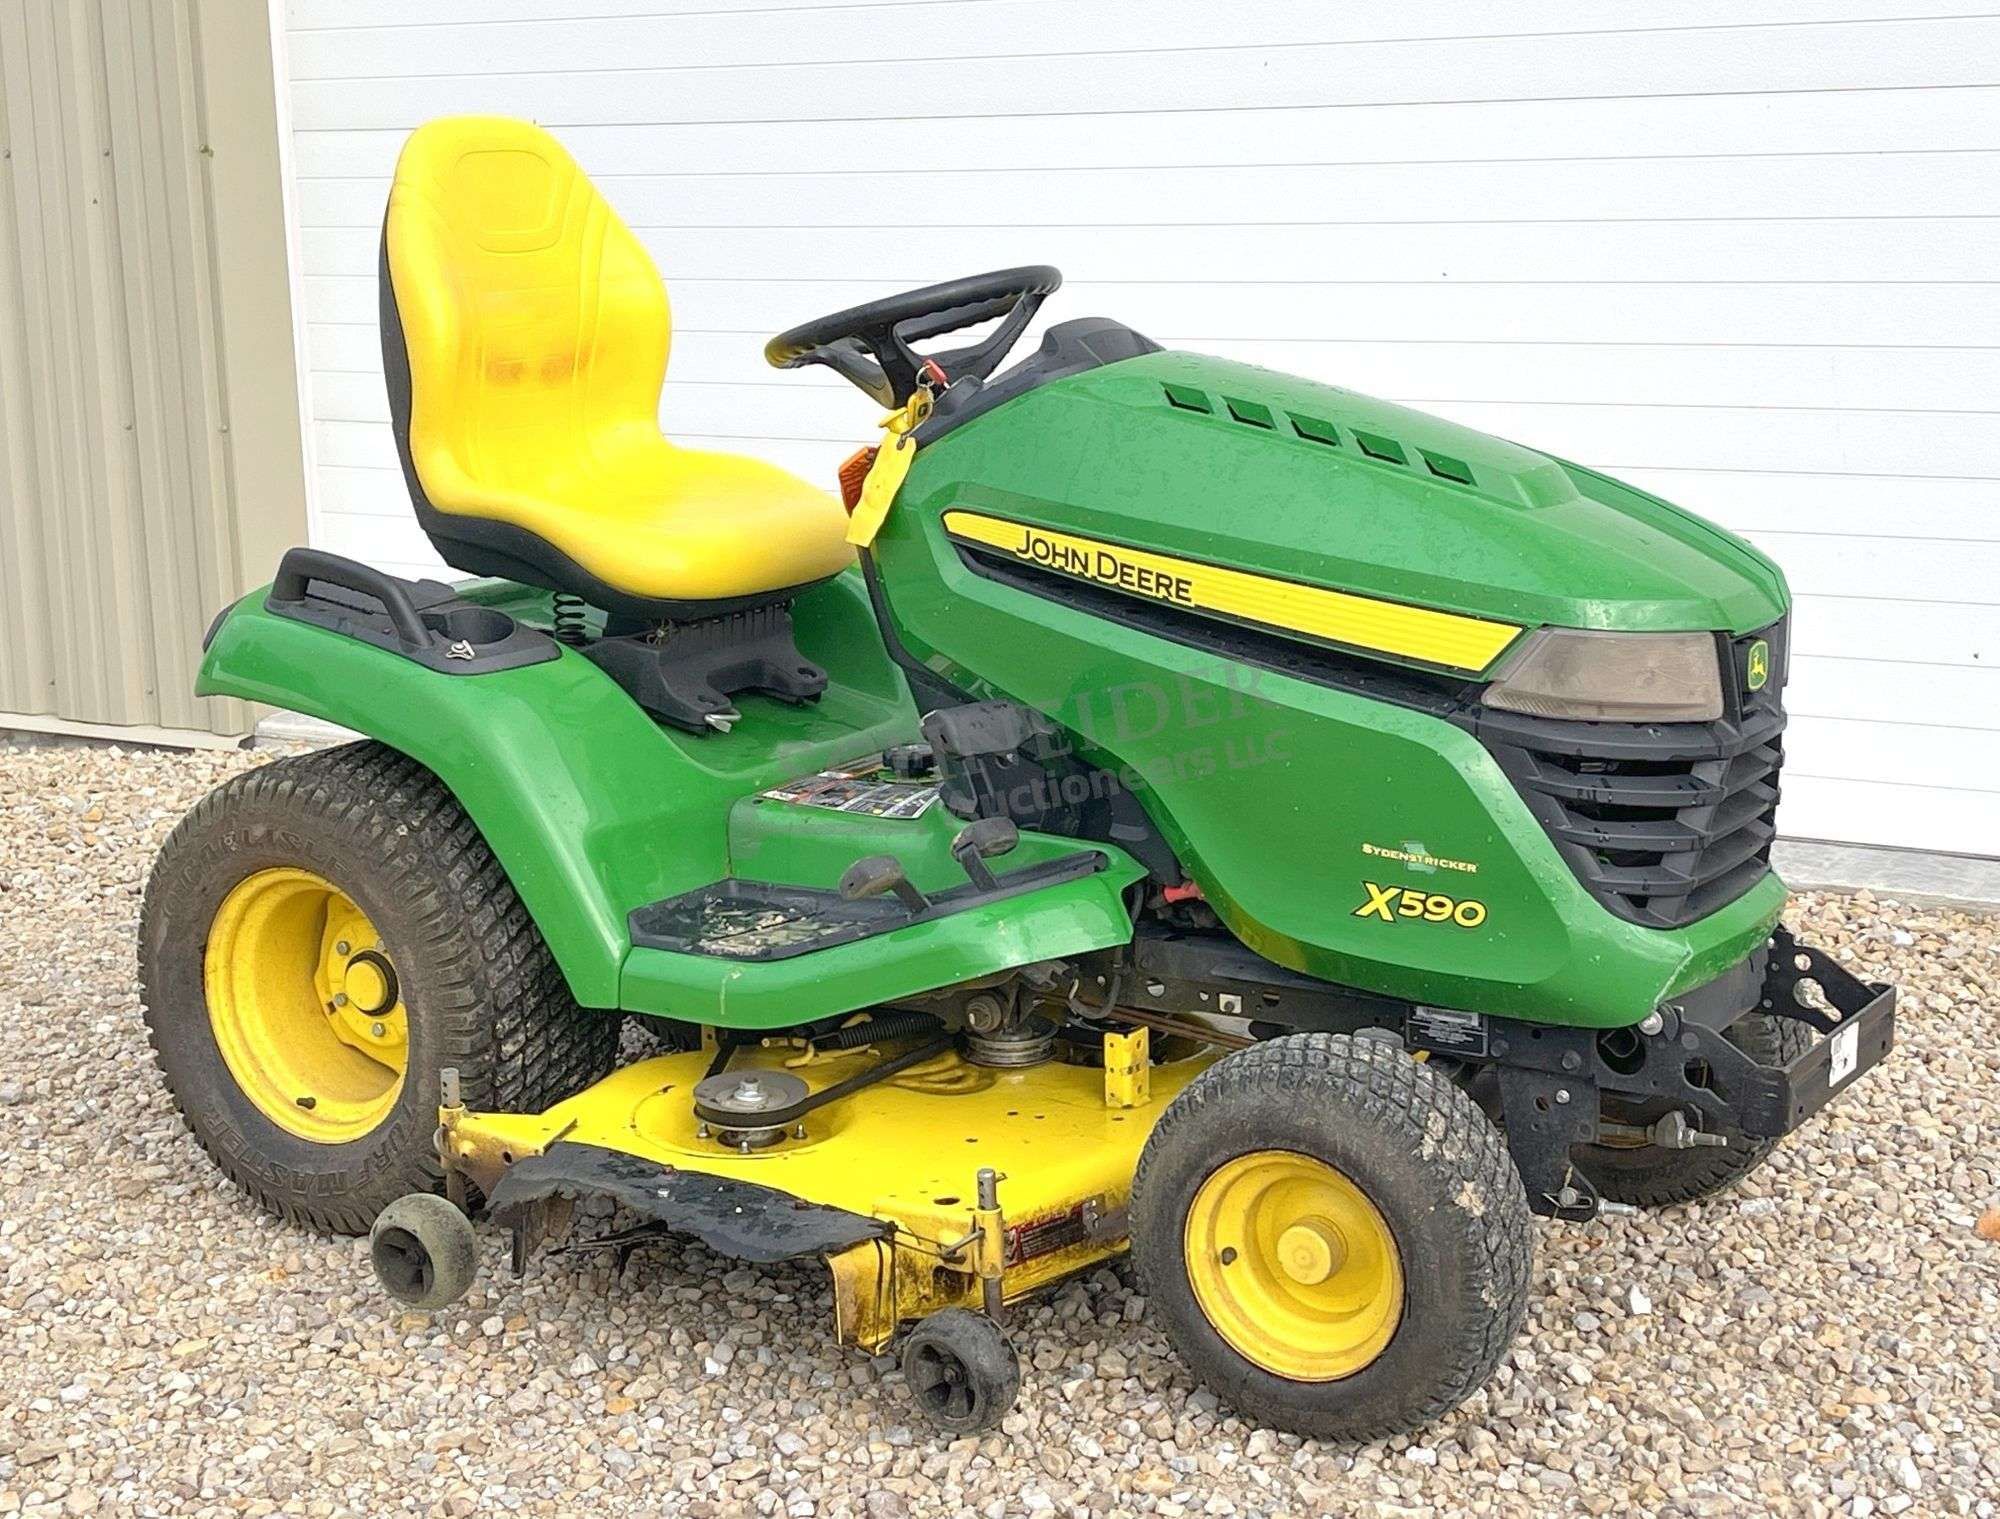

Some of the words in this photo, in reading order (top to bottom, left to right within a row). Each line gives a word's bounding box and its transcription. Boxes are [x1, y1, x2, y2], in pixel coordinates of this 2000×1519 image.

[1016, 530, 1089, 574] JOHN
[1096, 551, 1193, 603] DEERE
[1361, 843, 1478, 873] SYDENSTRICKER
[1351, 880, 1487, 928] X590
